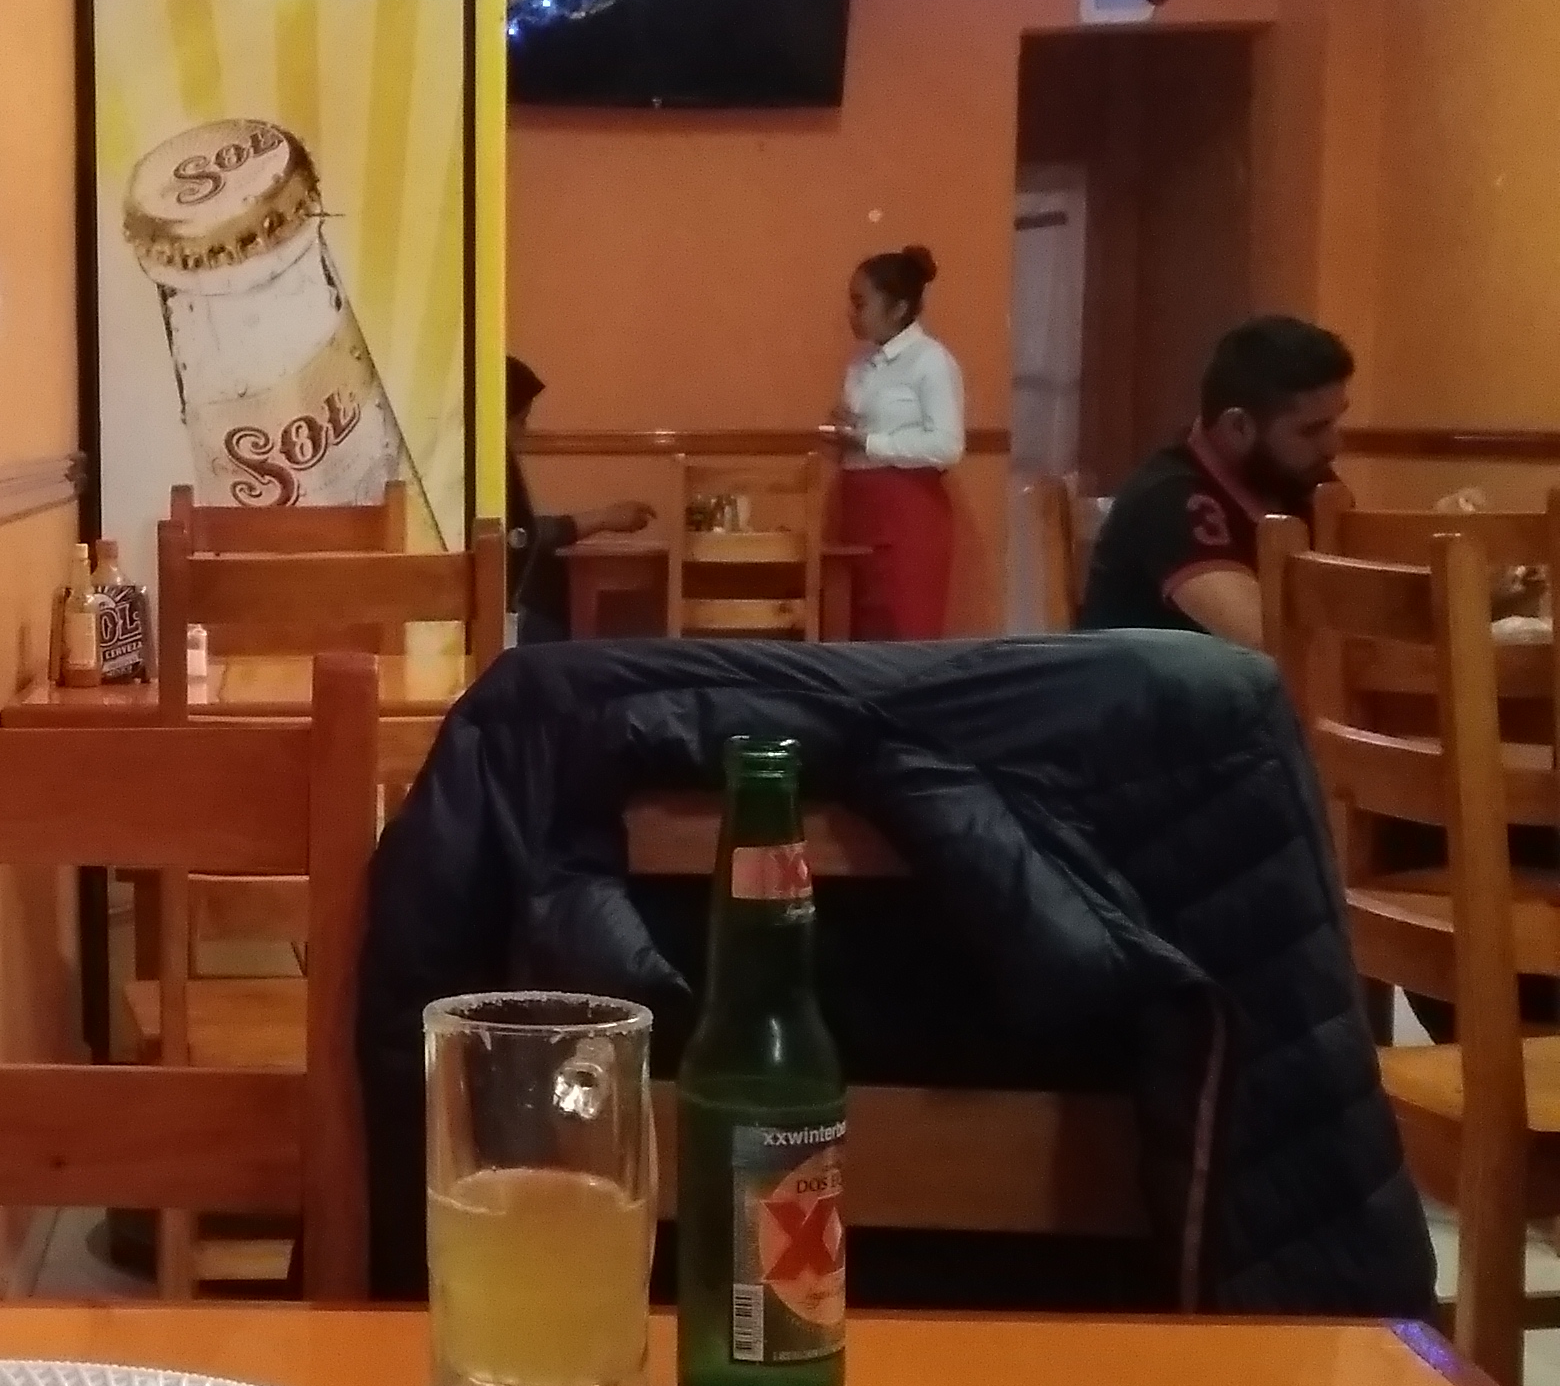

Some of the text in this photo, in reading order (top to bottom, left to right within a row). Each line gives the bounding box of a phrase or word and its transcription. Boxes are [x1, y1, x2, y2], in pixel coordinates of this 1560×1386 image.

[1186, 494, 1230, 545] 3
[100, 602, 142, 647] OL
[105, 641, 143, 659] CERVEZA
[796, 1176, 828, 1194] DOS
